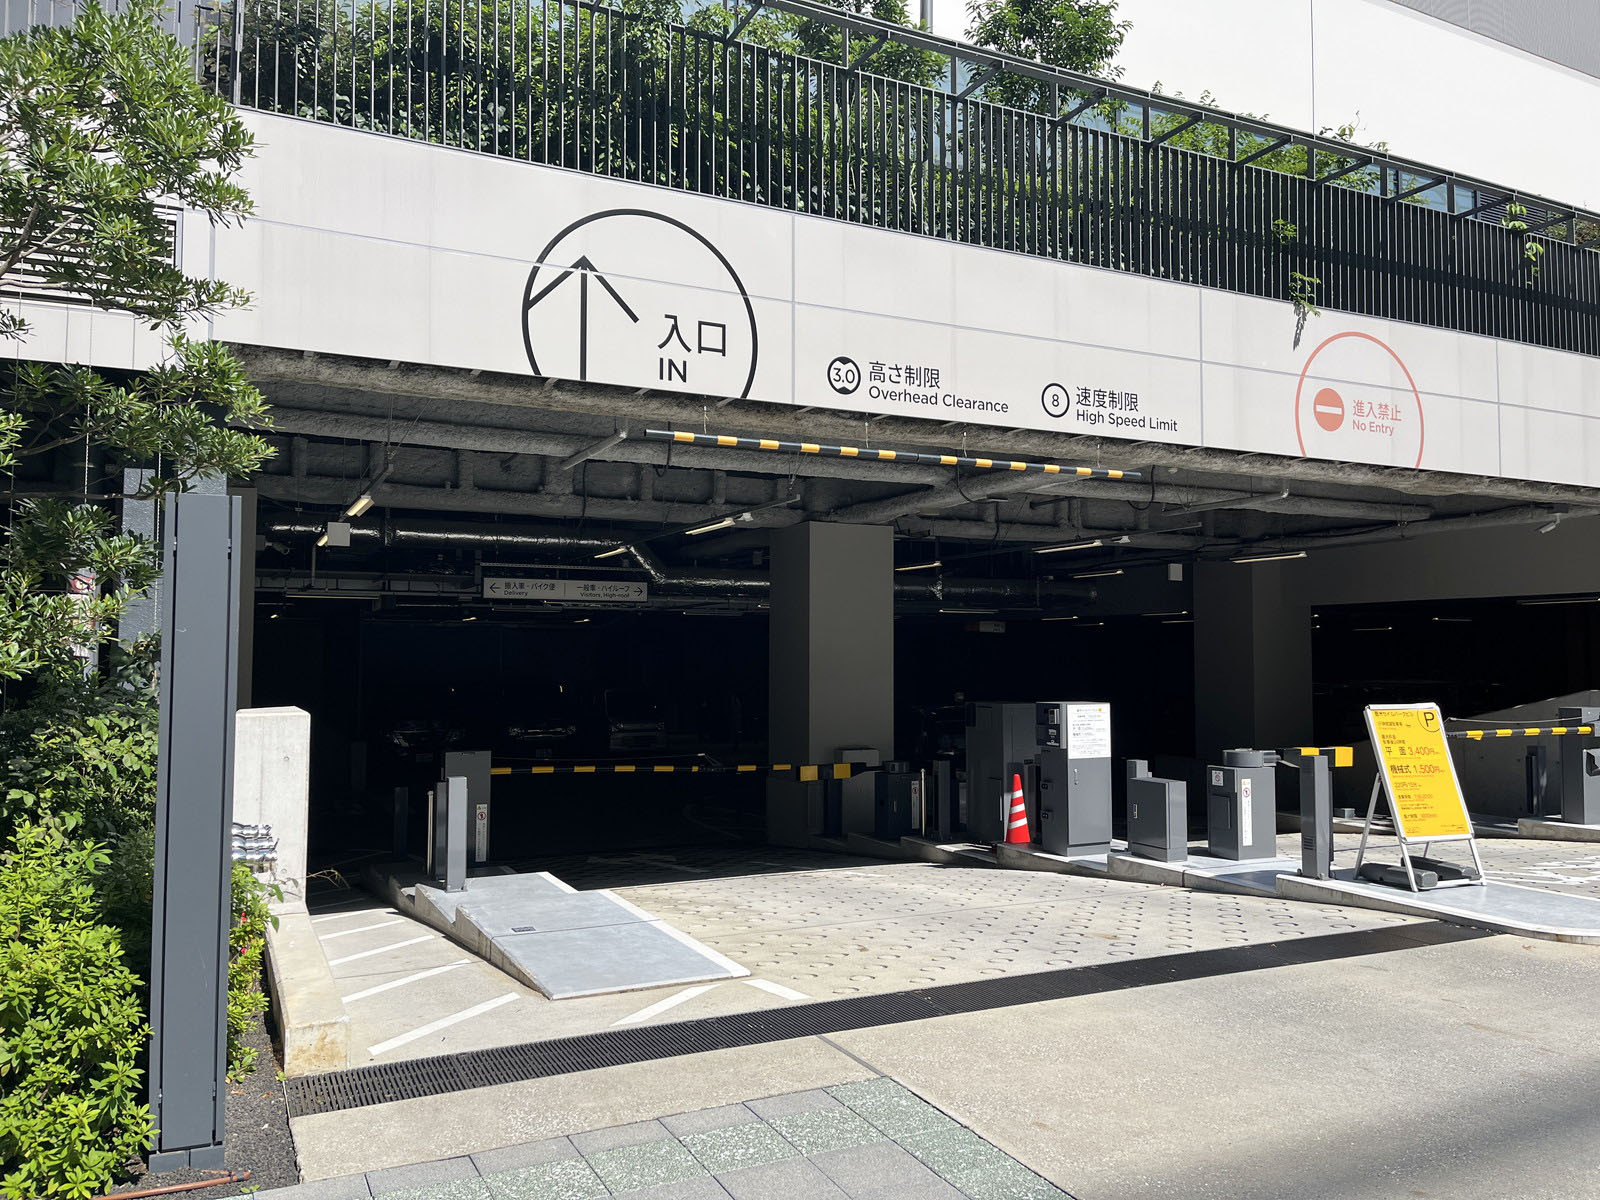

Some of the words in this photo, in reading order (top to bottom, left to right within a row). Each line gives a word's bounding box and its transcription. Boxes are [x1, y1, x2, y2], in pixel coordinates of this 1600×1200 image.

[658, 314, 726, 357] 入口
[659, 357, 687, 383] IN
[833, 367, 855, 384] 3.0
[868, 360, 941, 389] 高さ制限
[868, 385, 938, 406] Overhead
[942, 393, 1009, 414] Clearance
[1051, 393, 1060, 408] 8
[1075, 386, 1139, 412] 速度制限
[1353, 400, 1402, 422] 進入禁止
[1076, 408, 1105, 425] High
[1108, 412, 1146, 430] Speed
[1149, 416, 1178, 433] Limit
[1352, 419, 1367, 432] No
[1369, 421, 1394, 437] Entry
[1423, 711, 1435, 728] P
